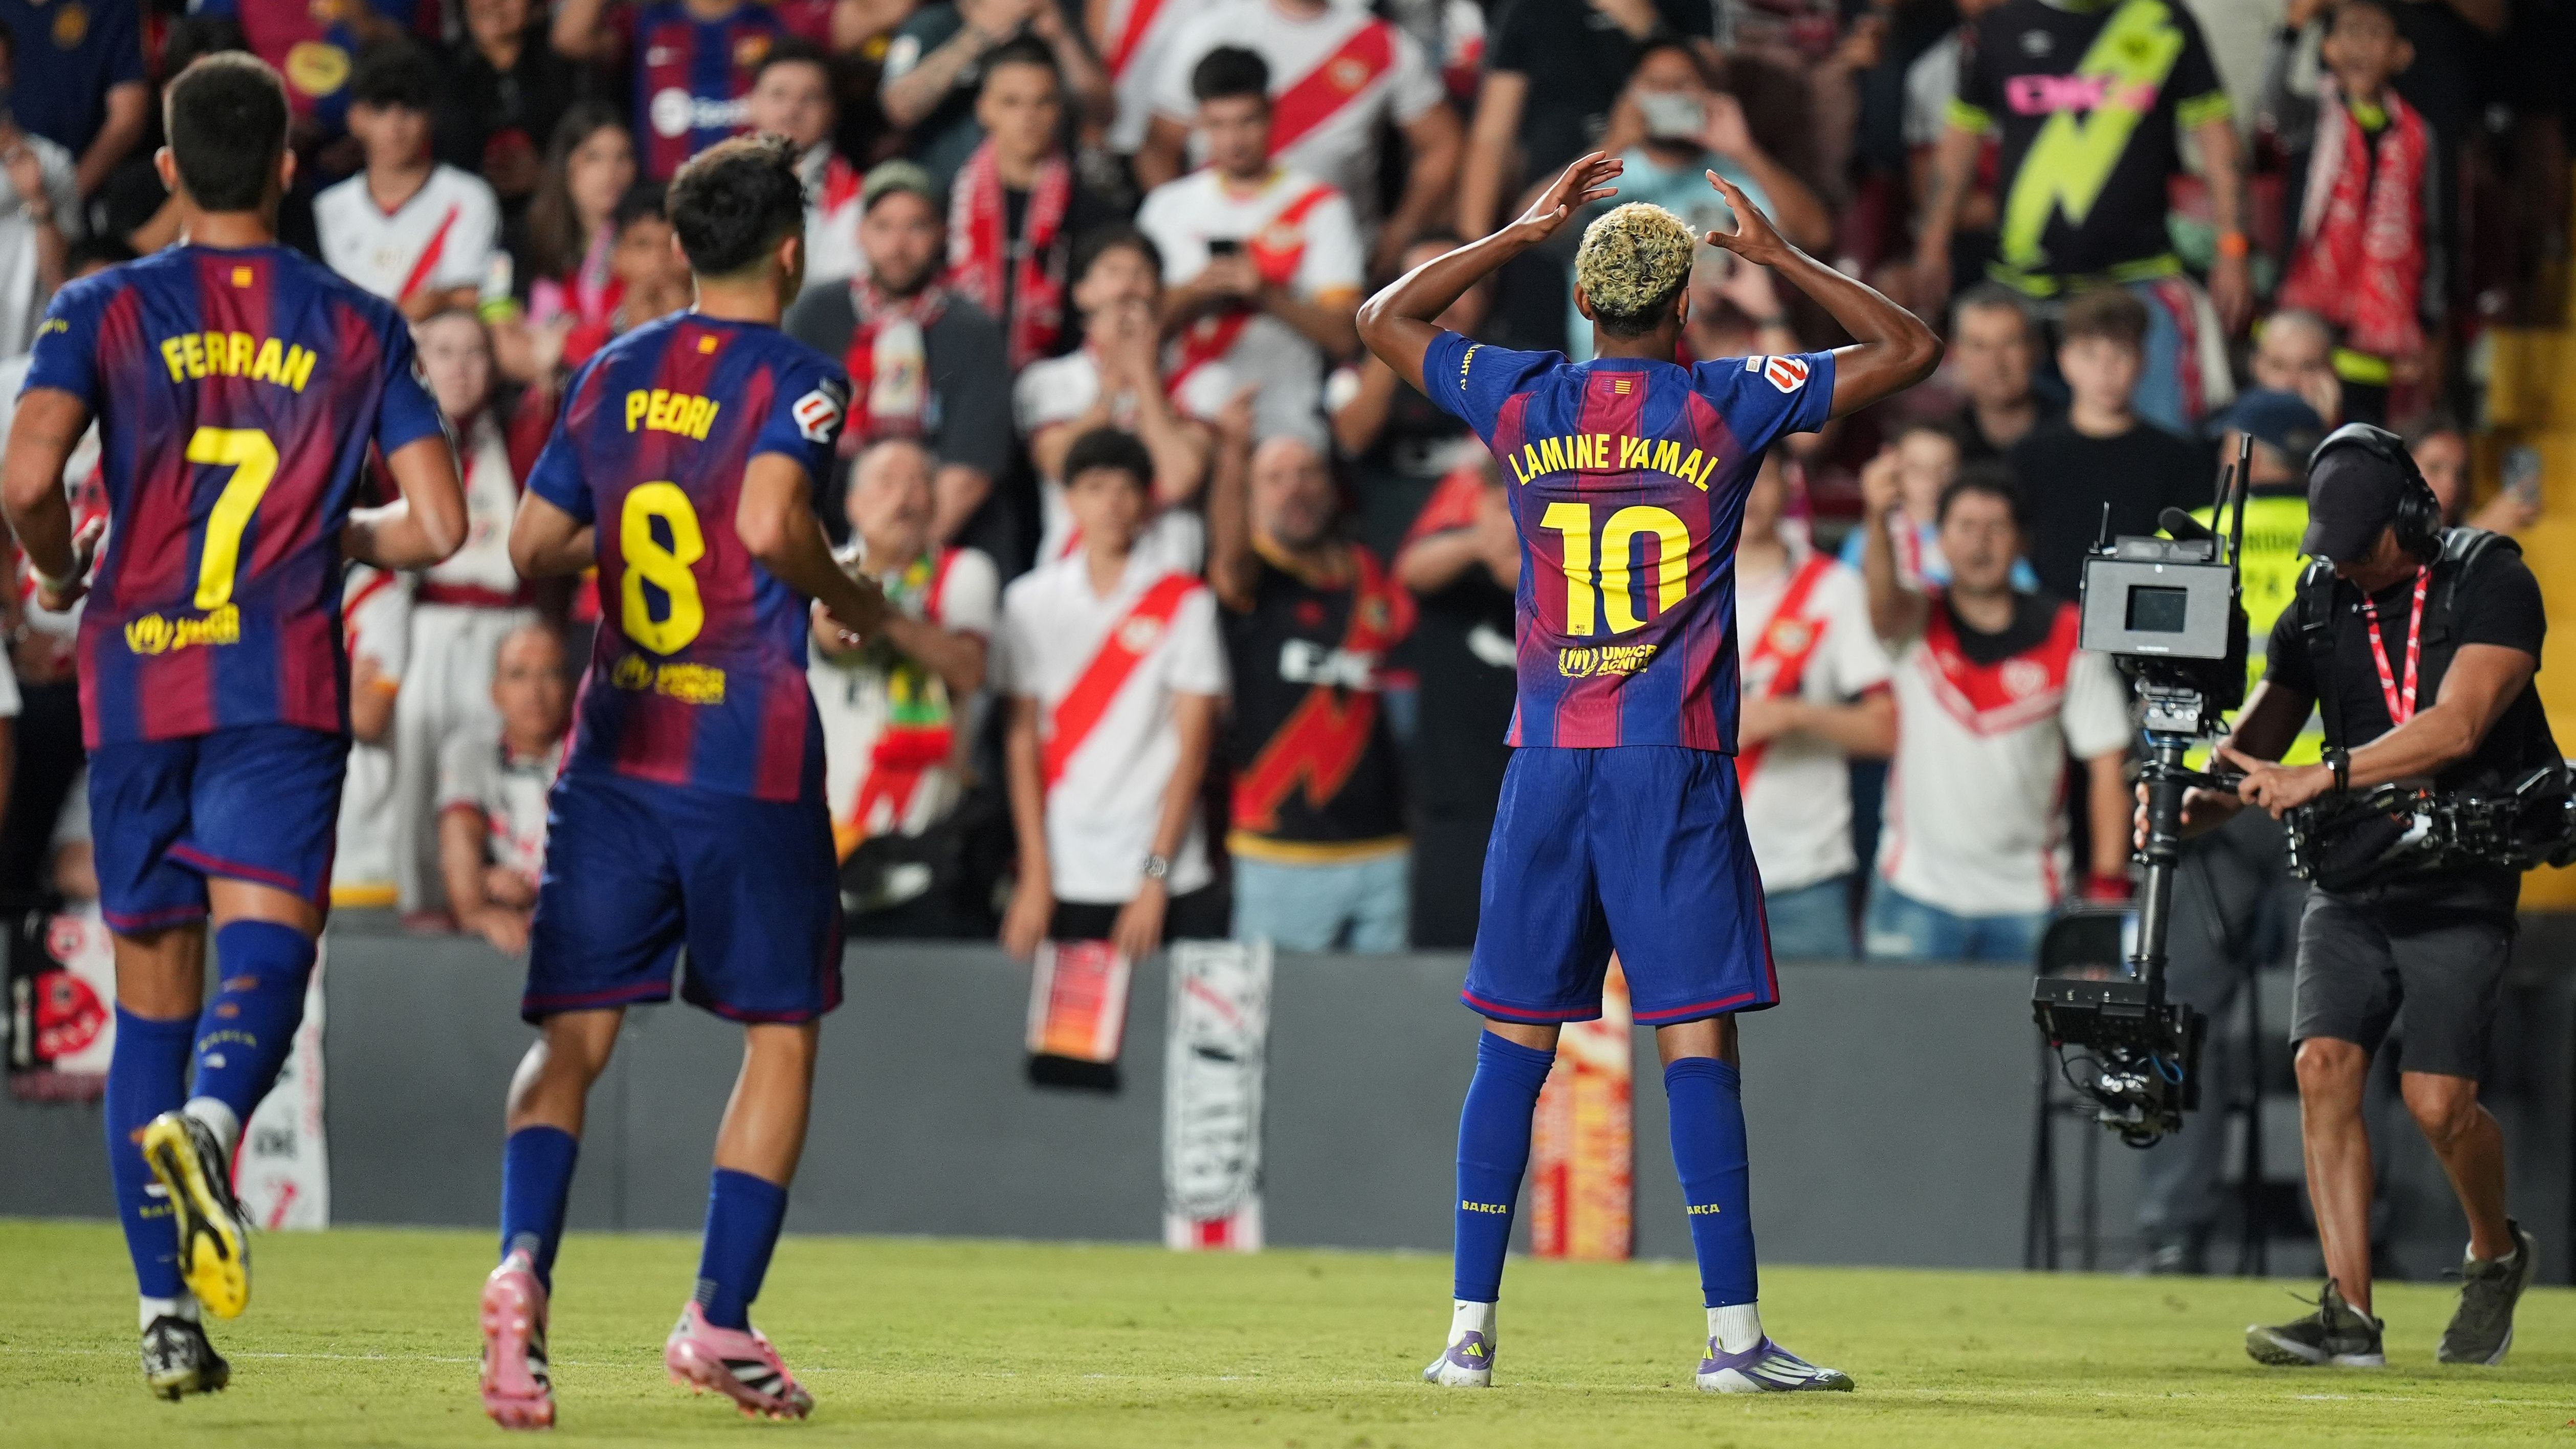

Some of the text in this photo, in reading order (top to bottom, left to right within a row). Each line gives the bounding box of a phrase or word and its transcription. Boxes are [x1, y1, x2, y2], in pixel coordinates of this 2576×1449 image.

[160, 331, 317, 393] FERRAN
[625, 388, 720, 442] PEDRI
[1508, 434, 1719, 492] LAMINE YAMAL
[185, 426, 279, 610] 7
[620, 480, 706, 656] 8
[1540, 502, 1690, 636] 10
[1463, 1200, 1506, 1214] BARÇA
[1687, 1203, 1720, 1215] ARÇA
